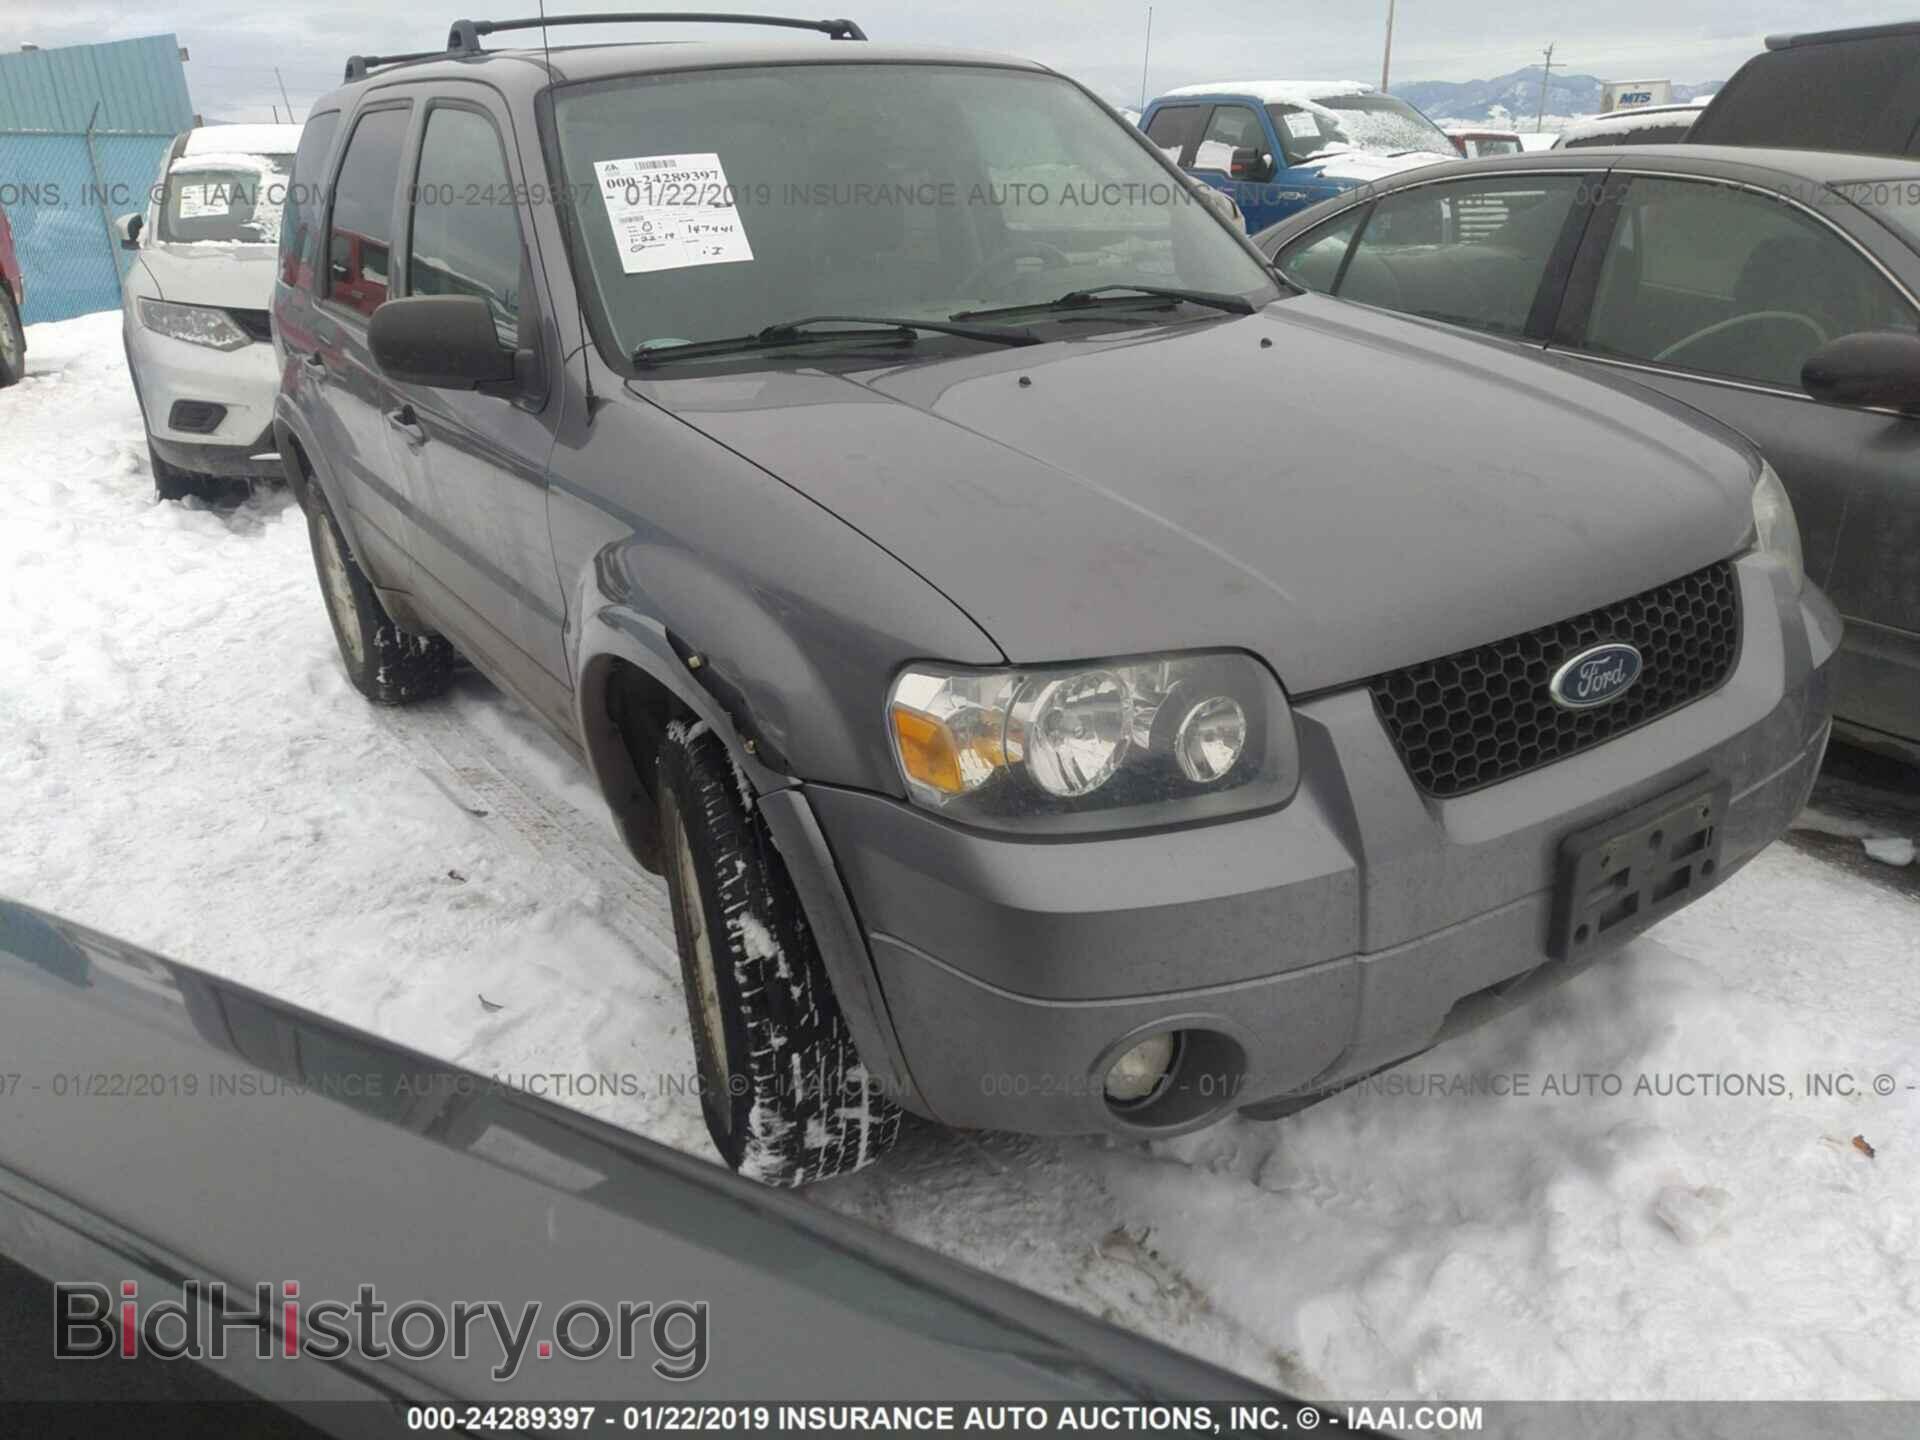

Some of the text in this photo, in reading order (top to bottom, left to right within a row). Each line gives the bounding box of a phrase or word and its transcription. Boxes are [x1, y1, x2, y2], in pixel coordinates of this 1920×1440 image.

[1619, 92, 1651, 104] MTS
[606, 170, 719, 189] 000-24289397
[1577, 655, 1626, 697] Ford
